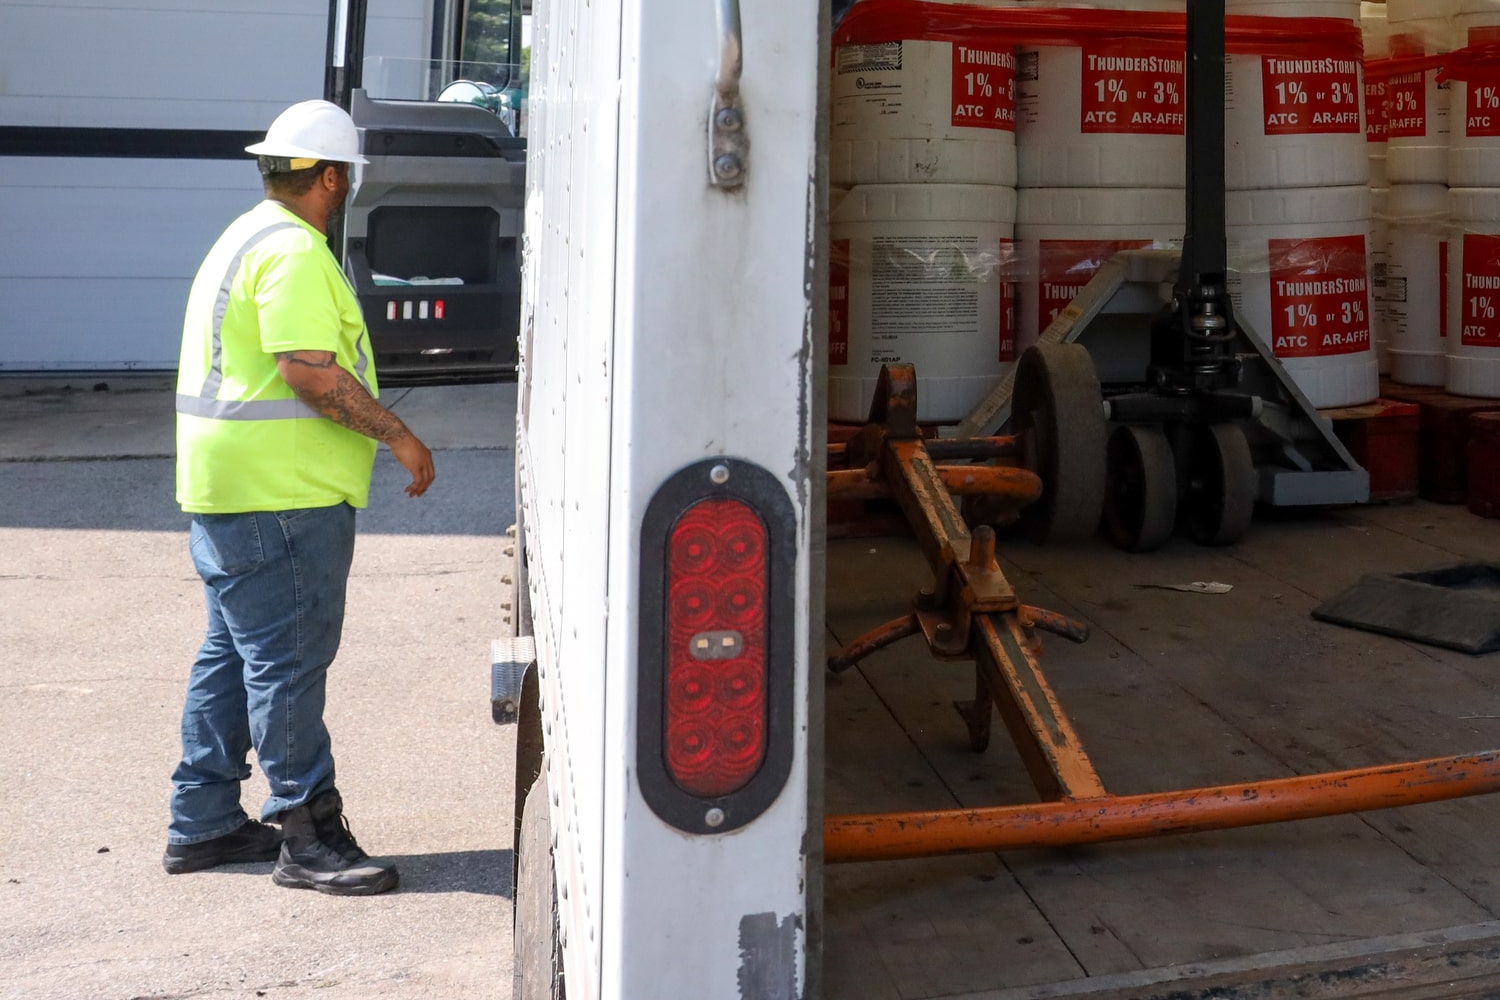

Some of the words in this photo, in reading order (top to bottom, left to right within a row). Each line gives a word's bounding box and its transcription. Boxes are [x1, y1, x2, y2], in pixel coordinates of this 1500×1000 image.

[964, 72, 993, 97] 1%
[998, 86, 1005, 95] or
[1094, 79, 1128, 103] 1%
[1136, 90, 1147, 99] or
[1153, 81, 1179, 105] 3%
[1275, 81, 1308, 104] 1%
[1316, 91, 1325, 100] or
[1331, 82, 1354, 104] 3%
[1397, 91, 1417, 111] 3%
[1474, 87, 1500, 109] 1%
[955, 104, 984, 118] ATC
[1085, 111, 1117, 123] ATC
[1131, 112, 1184, 125] AR-AFFF
[1267, 113, 1298, 125] ATC
[1312, 112, 1359, 124] AR-AFFF
[1468, 116, 1490, 128] ATC
[1284, 303, 1317, 328] 1%
[1325, 312, 1335, 321] or
[1341, 300, 1364, 324] 3%
[1469, 296, 1495, 318] 1%
[1276, 335, 1308, 348] ATC
[1322, 329, 1370, 346] AR-AFFF
[1463, 325, 1486, 337] ATC
